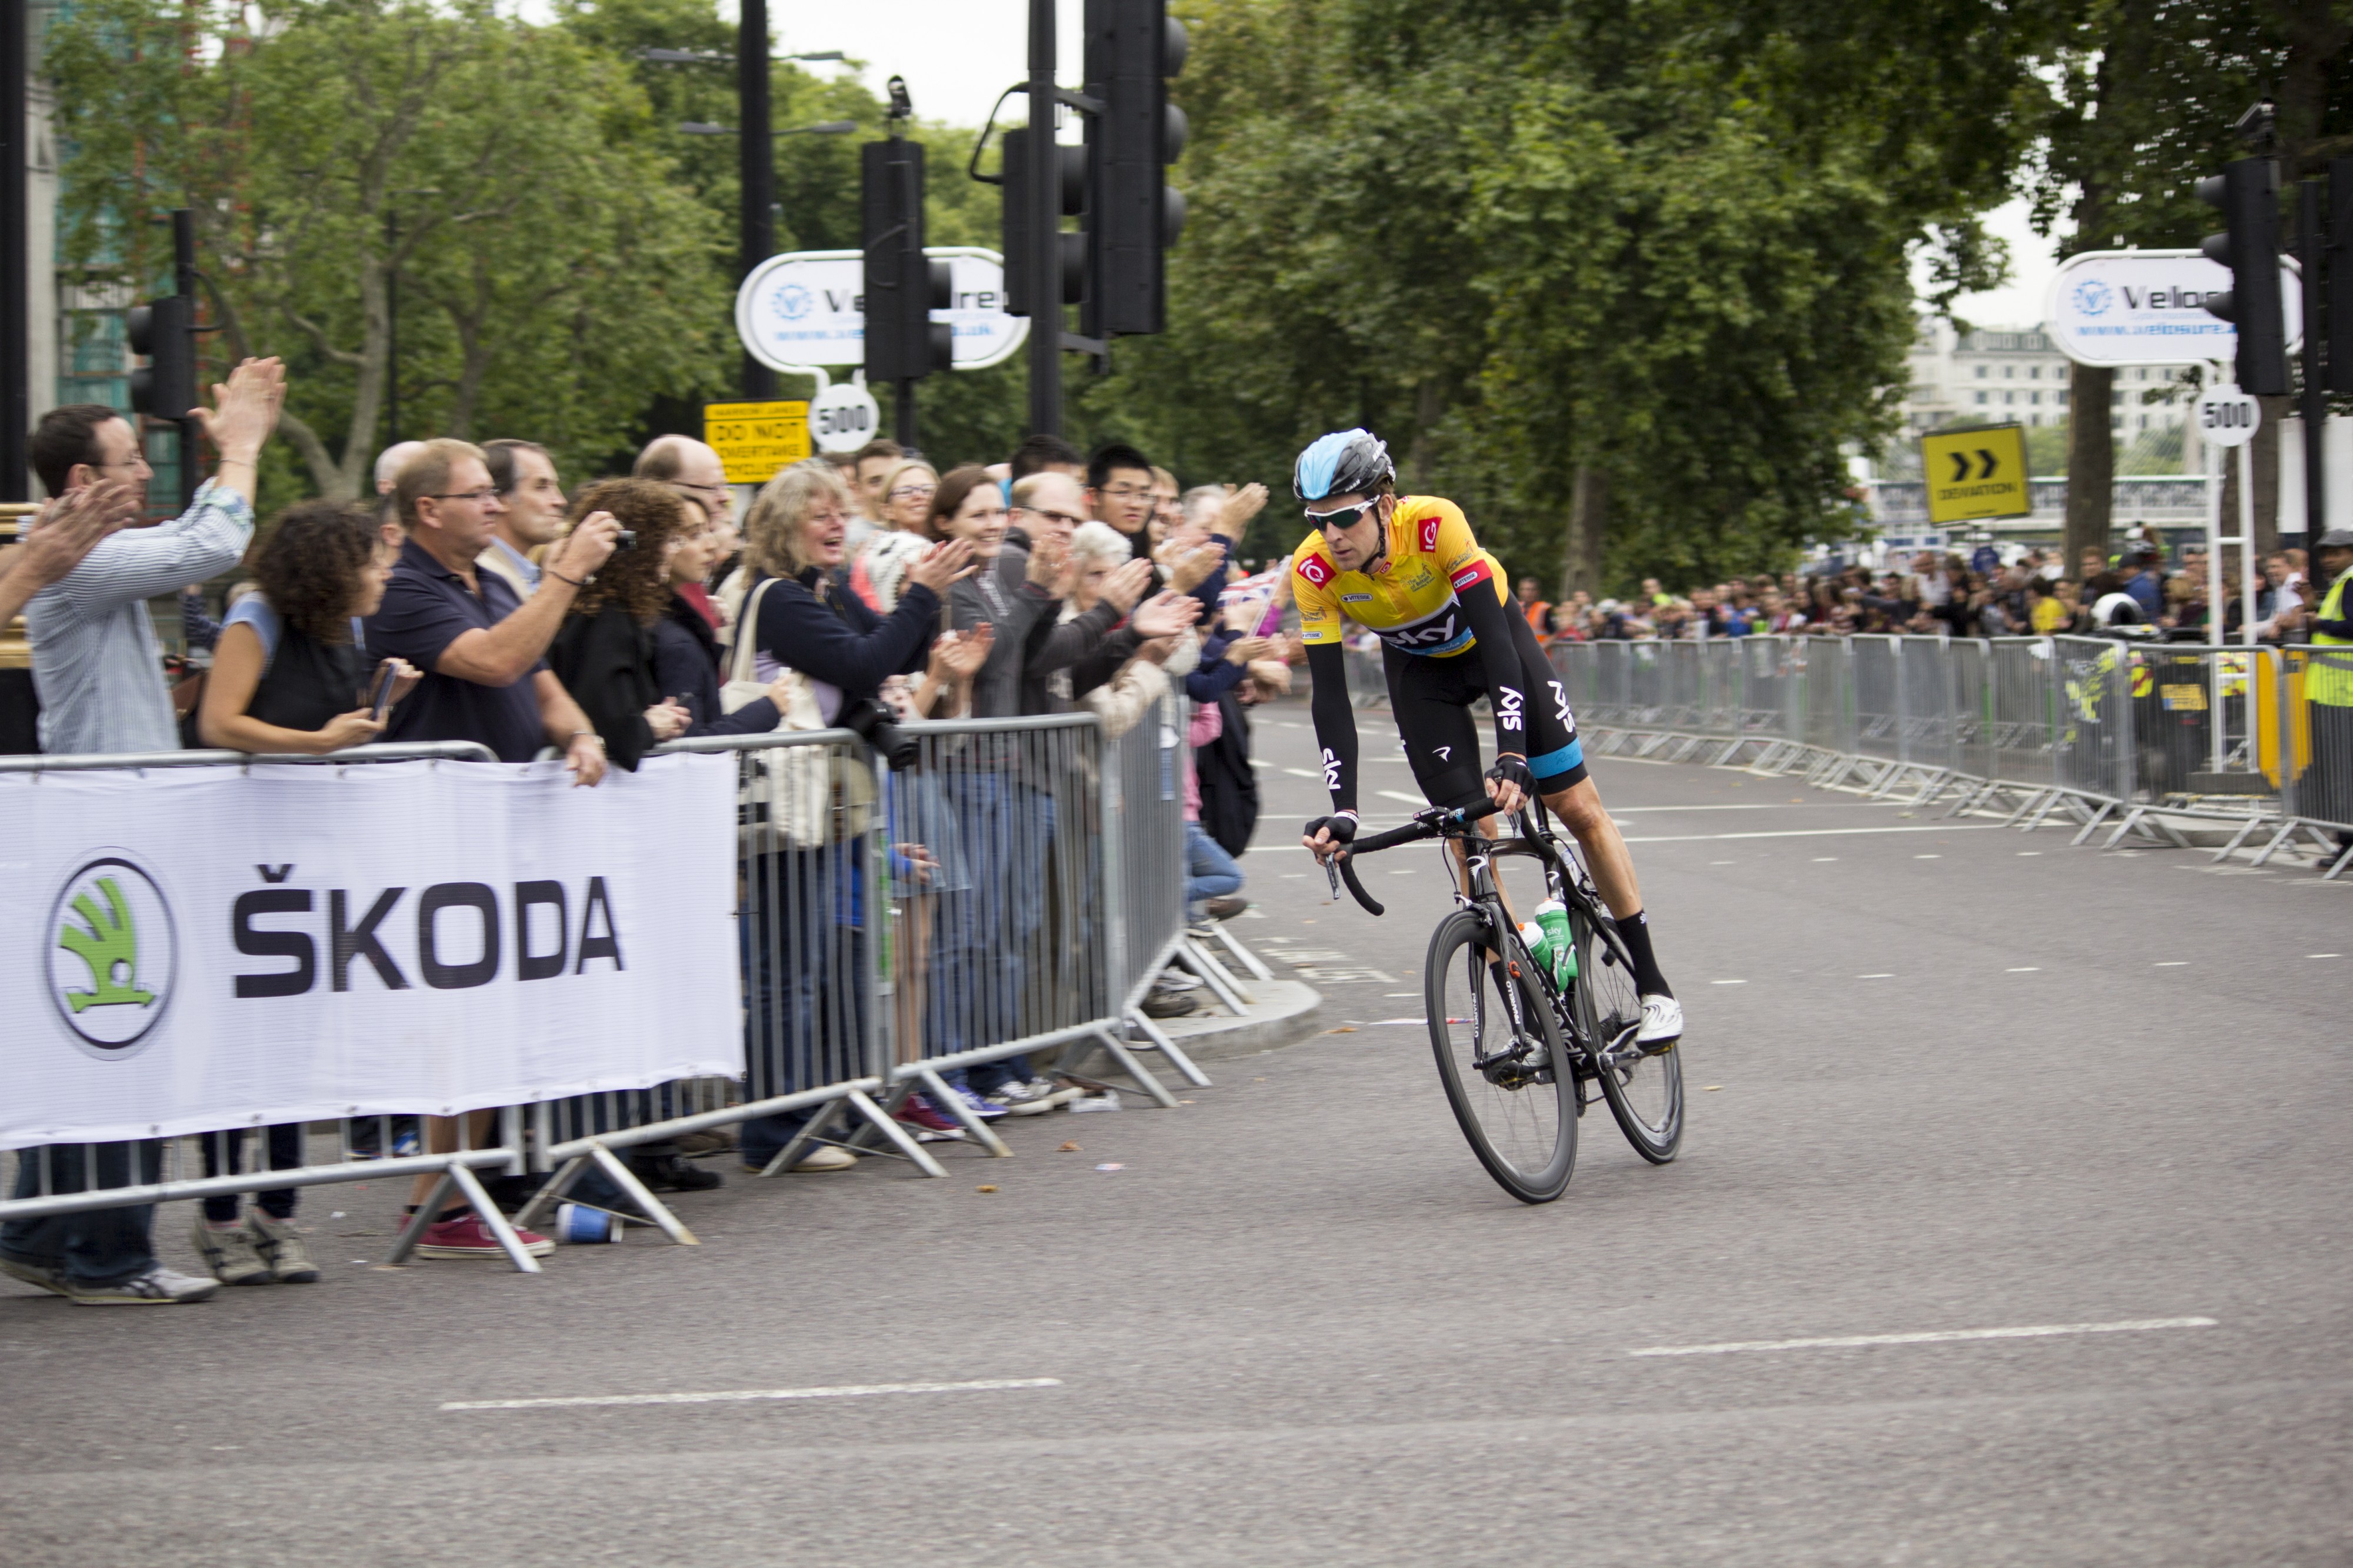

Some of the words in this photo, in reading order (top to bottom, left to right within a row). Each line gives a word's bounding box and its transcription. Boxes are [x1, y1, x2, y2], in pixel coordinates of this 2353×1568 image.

[2122, 286, 2219, 309] Velo
[818, 404, 868, 435] 500
[2202, 402, 2251, 428] 500
[715, 425, 746, 441] DO
[754, 422, 800, 439] NOT
[1424, 522, 1437, 550] IG
[1299, 558, 1324, 582] IG
[1457, 573, 1476, 585] VITESSE
[1497, 686, 1524, 731] sky
[1547, 680, 1576, 733] sky
[233, 863, 625, 998] ŠKODA
[1547, 926, 1562, 936] sky
[1506, 980, 1521, 1025] PINARELLO
